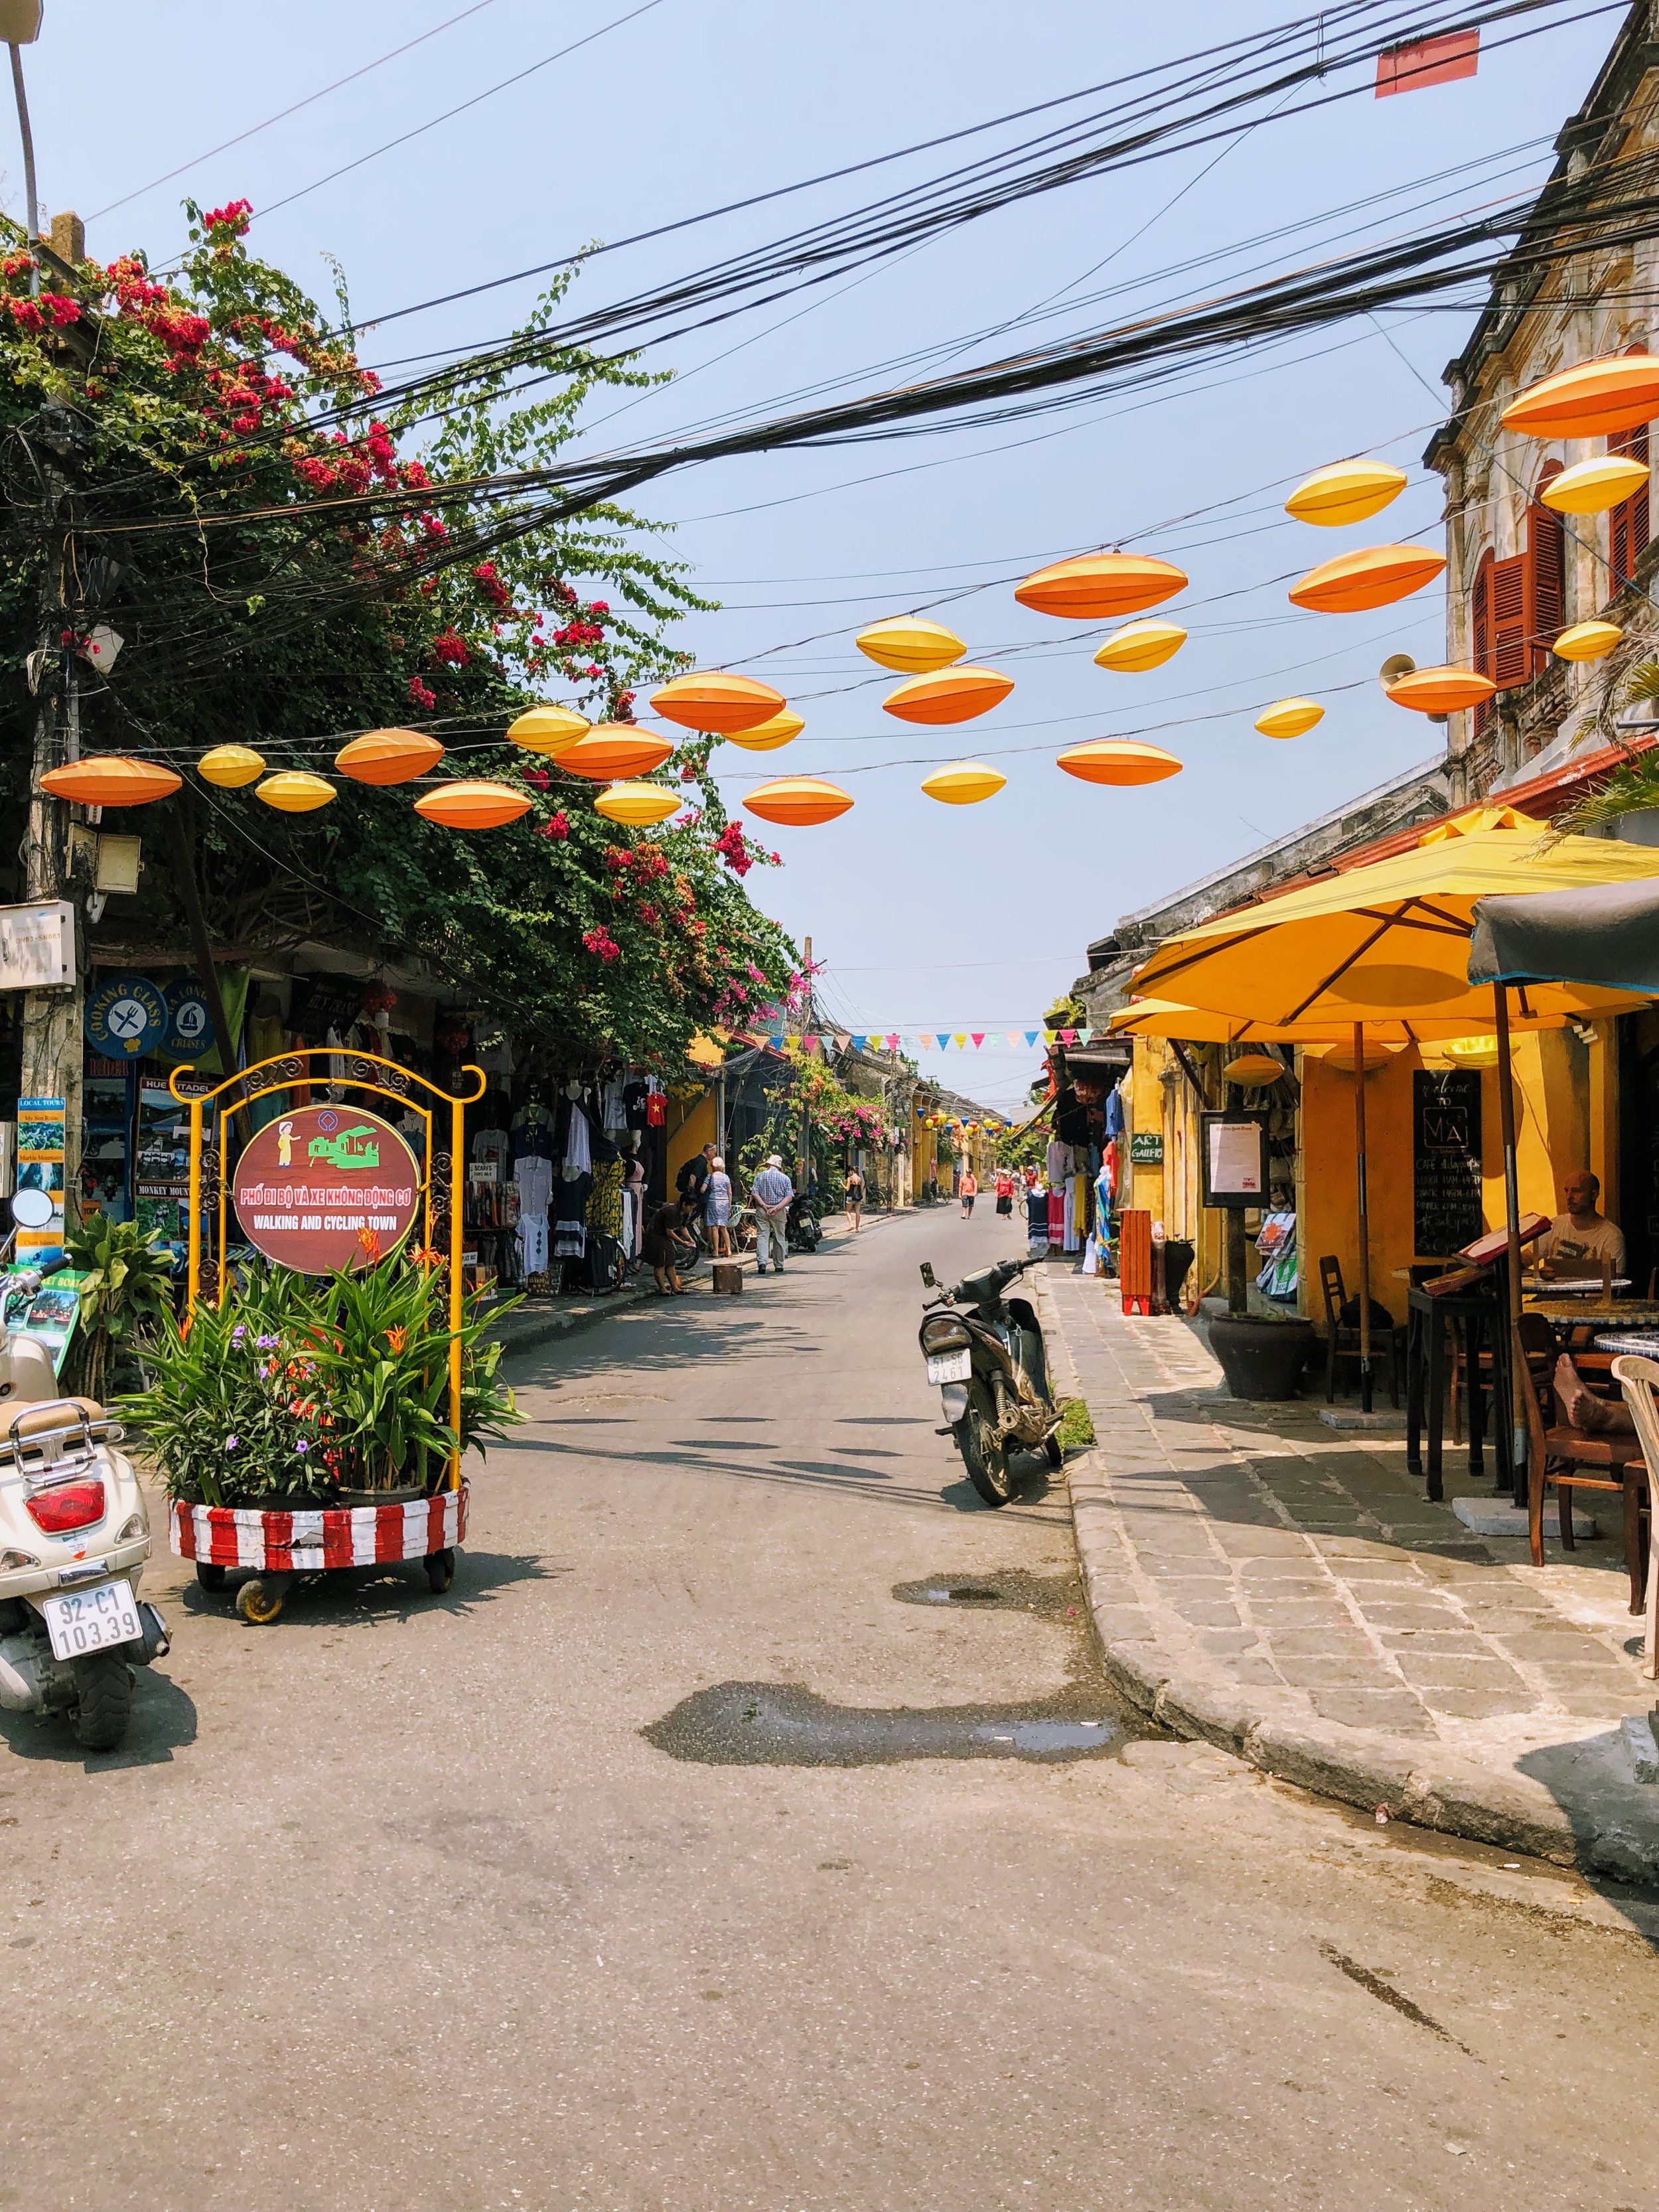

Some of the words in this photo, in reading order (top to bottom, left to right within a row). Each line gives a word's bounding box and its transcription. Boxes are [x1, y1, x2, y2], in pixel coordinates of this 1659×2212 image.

[179, 986, 207, 1000] LONG
[91, 984, 127, 1041] COOKING
[133, 986, 161, 1027] CLASS
[171, 1038, 206, 1049] CRUISES
[147, 1080, 167, 1089] HUE
[176, 1083, 210, 1092] ITADEL
[1132, 1136, 1162, 1145] ART
[1131, 1148, 1162, 1159] GALLERY
[139, 1185, 167, 1195] MONKEY
[240, 1183, 264, 1205] PHỐ
[264, 1188, 277, 1205] ĐI
[277, 1185, 293, 1209] BỘ
[295, 1185, 308, 1205] VÀ
[309, 1188, 325, 1205] XE
[326, 1186, 363, 1205] KHÔNG
[364, 1186, 395, 1209] ĐỘNG
[395, 1187, 411, 1206] CƠ
[253, 1215, 299, 1230] WALKING
[301, 1216, 322, 1230] AND
[324, 1216, 365, 1230] CYCLING
[368, 1216, 397, 1230] TOWN
[934, 1366, 963, 1383] 2461
[59, 1587, 119, 1625] 92-C1
[59, 1612, 136, 1653] 103.39
